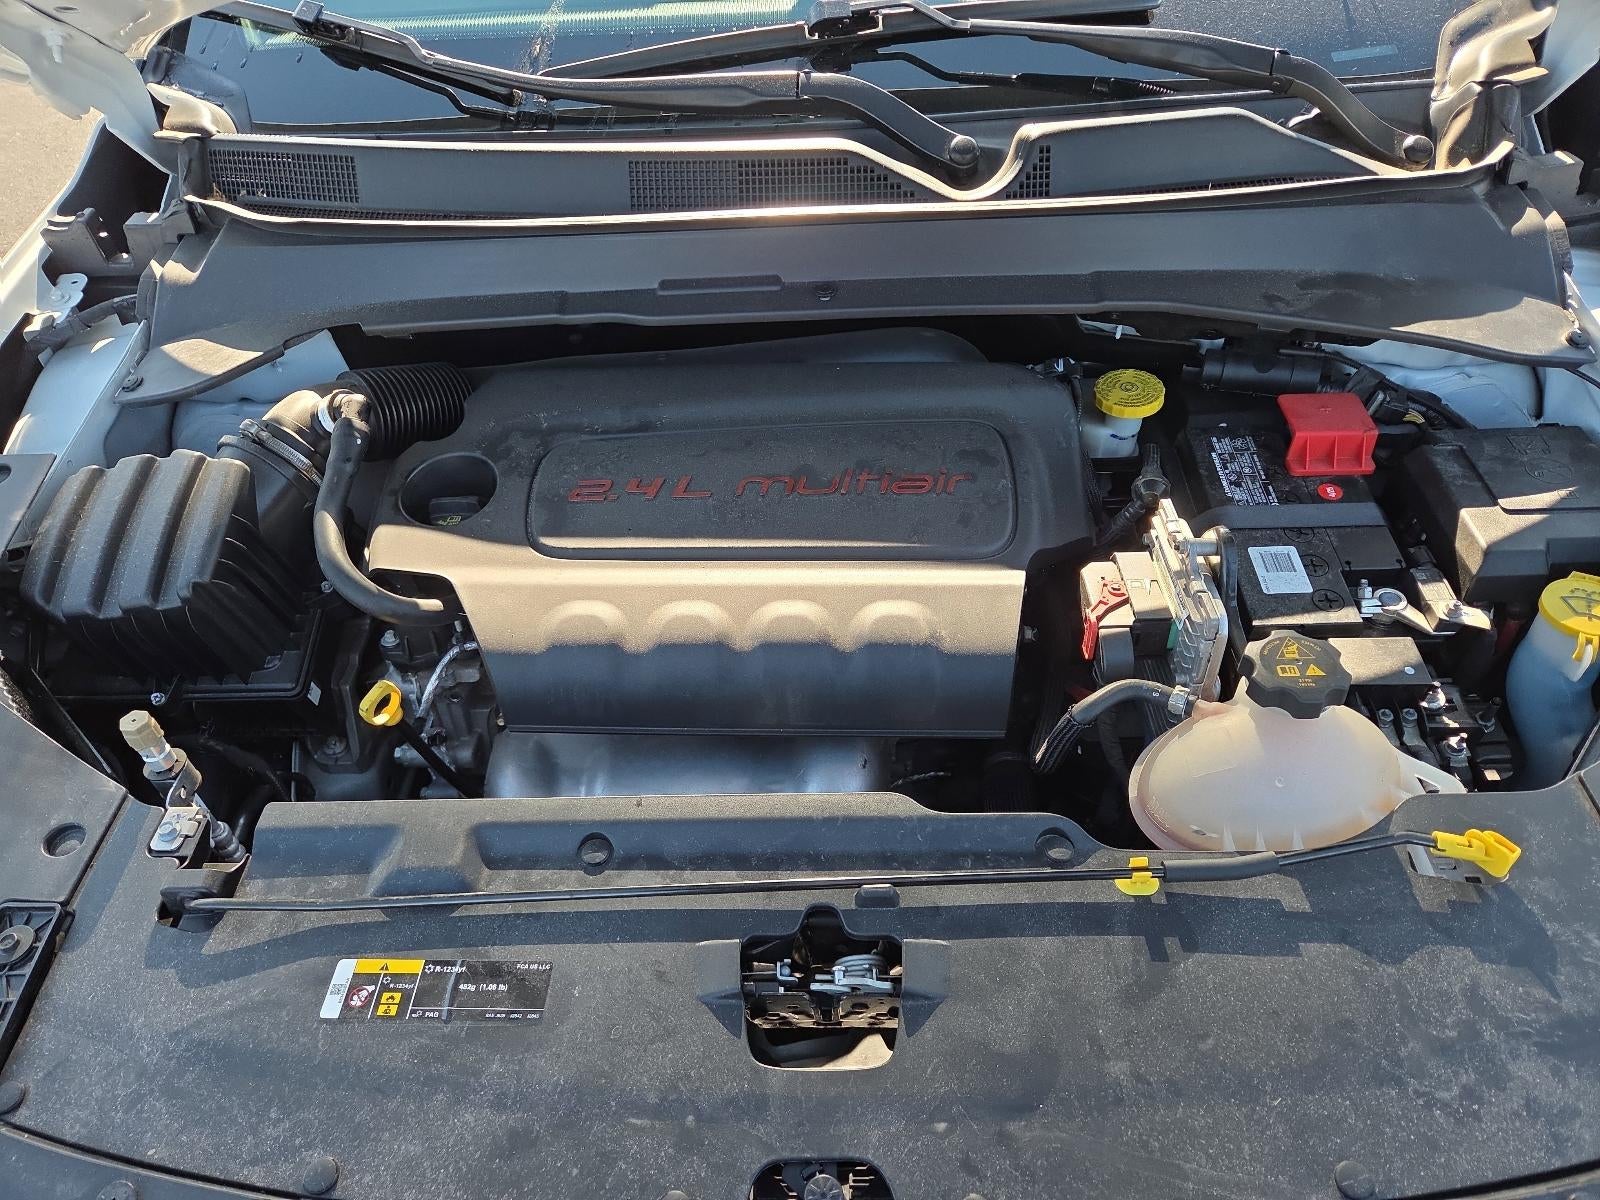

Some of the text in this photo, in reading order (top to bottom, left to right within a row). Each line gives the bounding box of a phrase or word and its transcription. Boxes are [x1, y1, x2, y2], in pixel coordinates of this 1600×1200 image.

[671, 474, 713, 500] L
[735, 467, 974, 497] multiair
[539, 962, 551, 970] LLC
[498, 983, 508, 992] lb)
